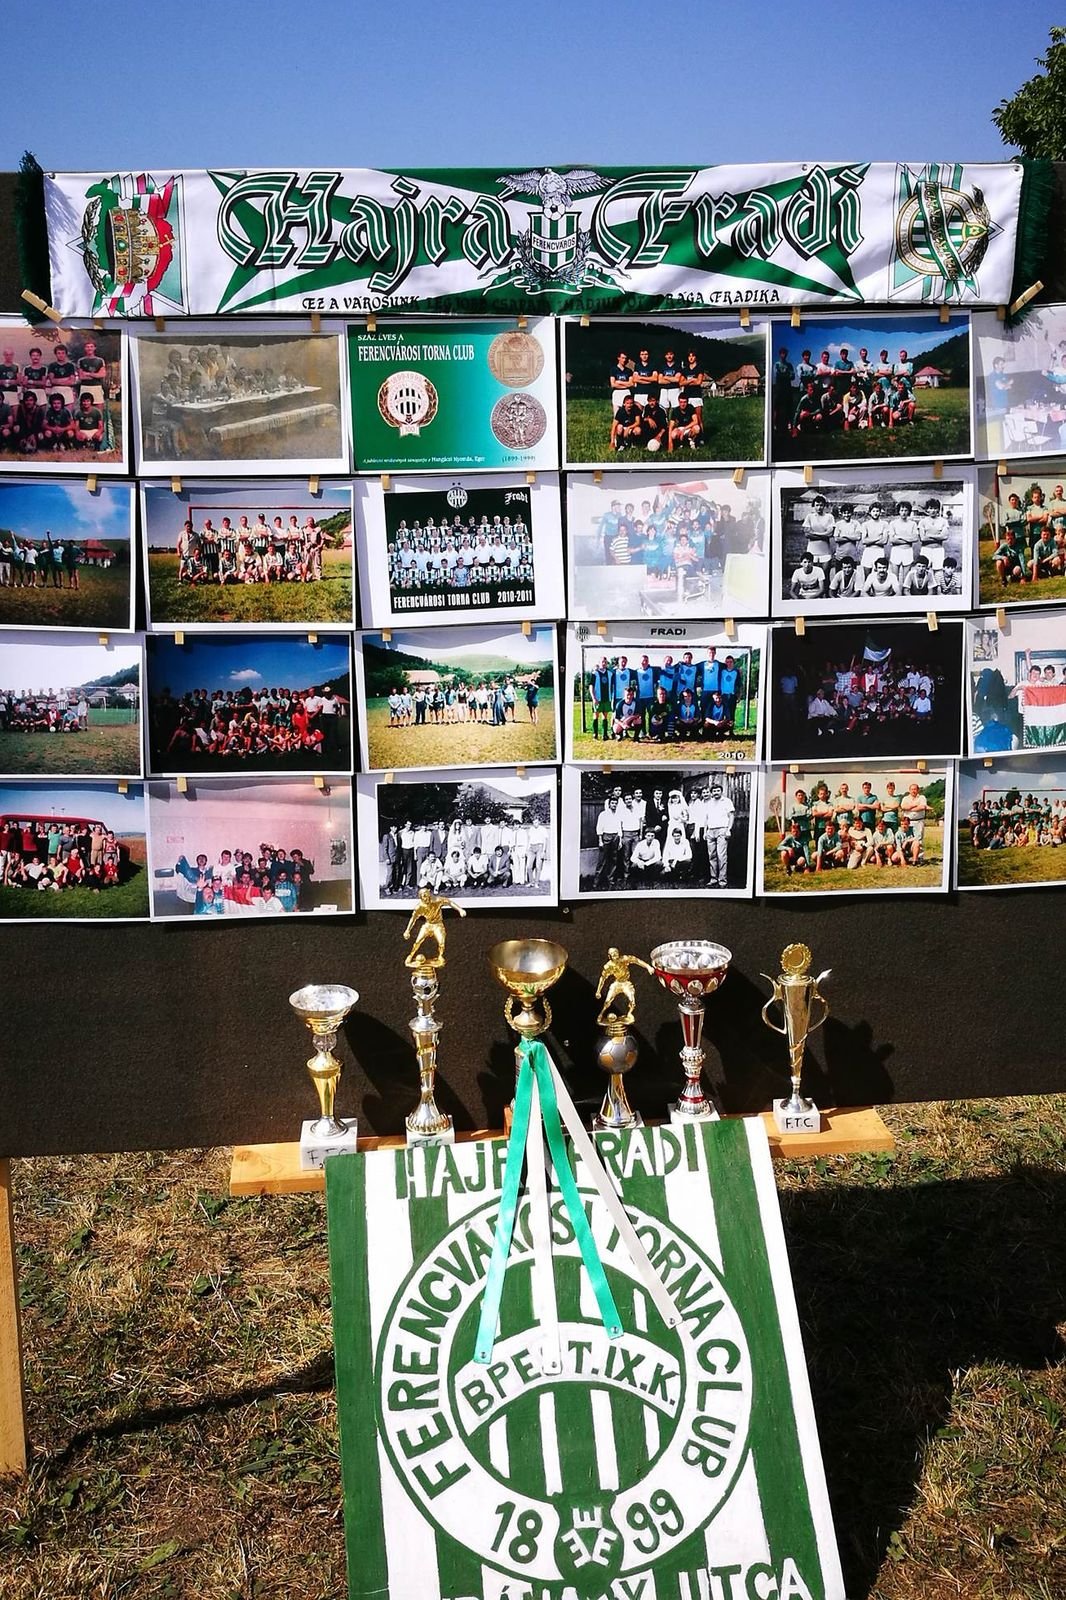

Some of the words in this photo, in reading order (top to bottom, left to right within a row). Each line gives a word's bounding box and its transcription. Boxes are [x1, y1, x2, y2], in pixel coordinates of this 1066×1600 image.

[217, 172, 515, 295] Hajrá
[591, 165, 866, 269] Fradi
[532, 236, 577, 251] FERENCVÁROS
[329, 297, 340, 310] A
[343, 296, 420, 312] VÁROSUNK
[709, 288, 780, 305] FRADIKA
[358, 340, 421, 361] FERENCVÁROSI
[422, 344, 451, 361] TORNA
[452, 344, 475, 361] CLUB
[393, 593, 446, 609] FERENCVÁROSI
[447, 593, 471, 606] TORNA
[472, 591, 491, 605] CLUB
[497, 589, 533, 604] 2010-2011
[650, 628, 687, 636] FRADI
[718, 750, 746, 760] 2010
[460, 1340, 680, 1417] BPET.IX.K.
[681, 1338, 743, 1479] CLUB
[489, 1500, 544, 1564] 18
[626, 1488, 685, 1554] 99
